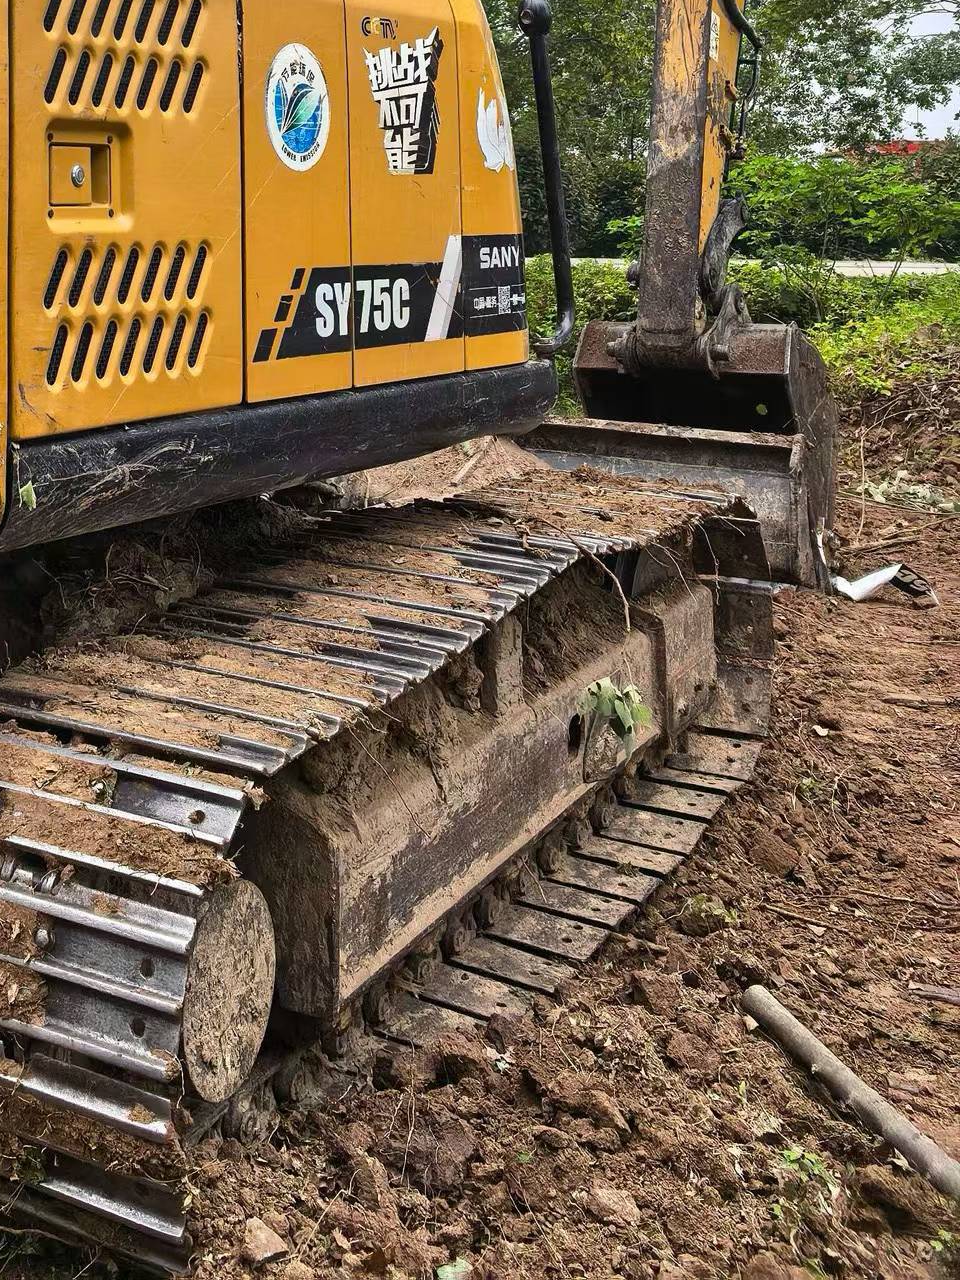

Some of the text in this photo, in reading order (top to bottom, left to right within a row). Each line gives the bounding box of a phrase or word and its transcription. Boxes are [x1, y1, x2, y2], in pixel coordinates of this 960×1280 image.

[363, 26, 439, 91] 挑战
[479, 245, 520, 269] SANY
[315, 278, 410, 338] SY75C
